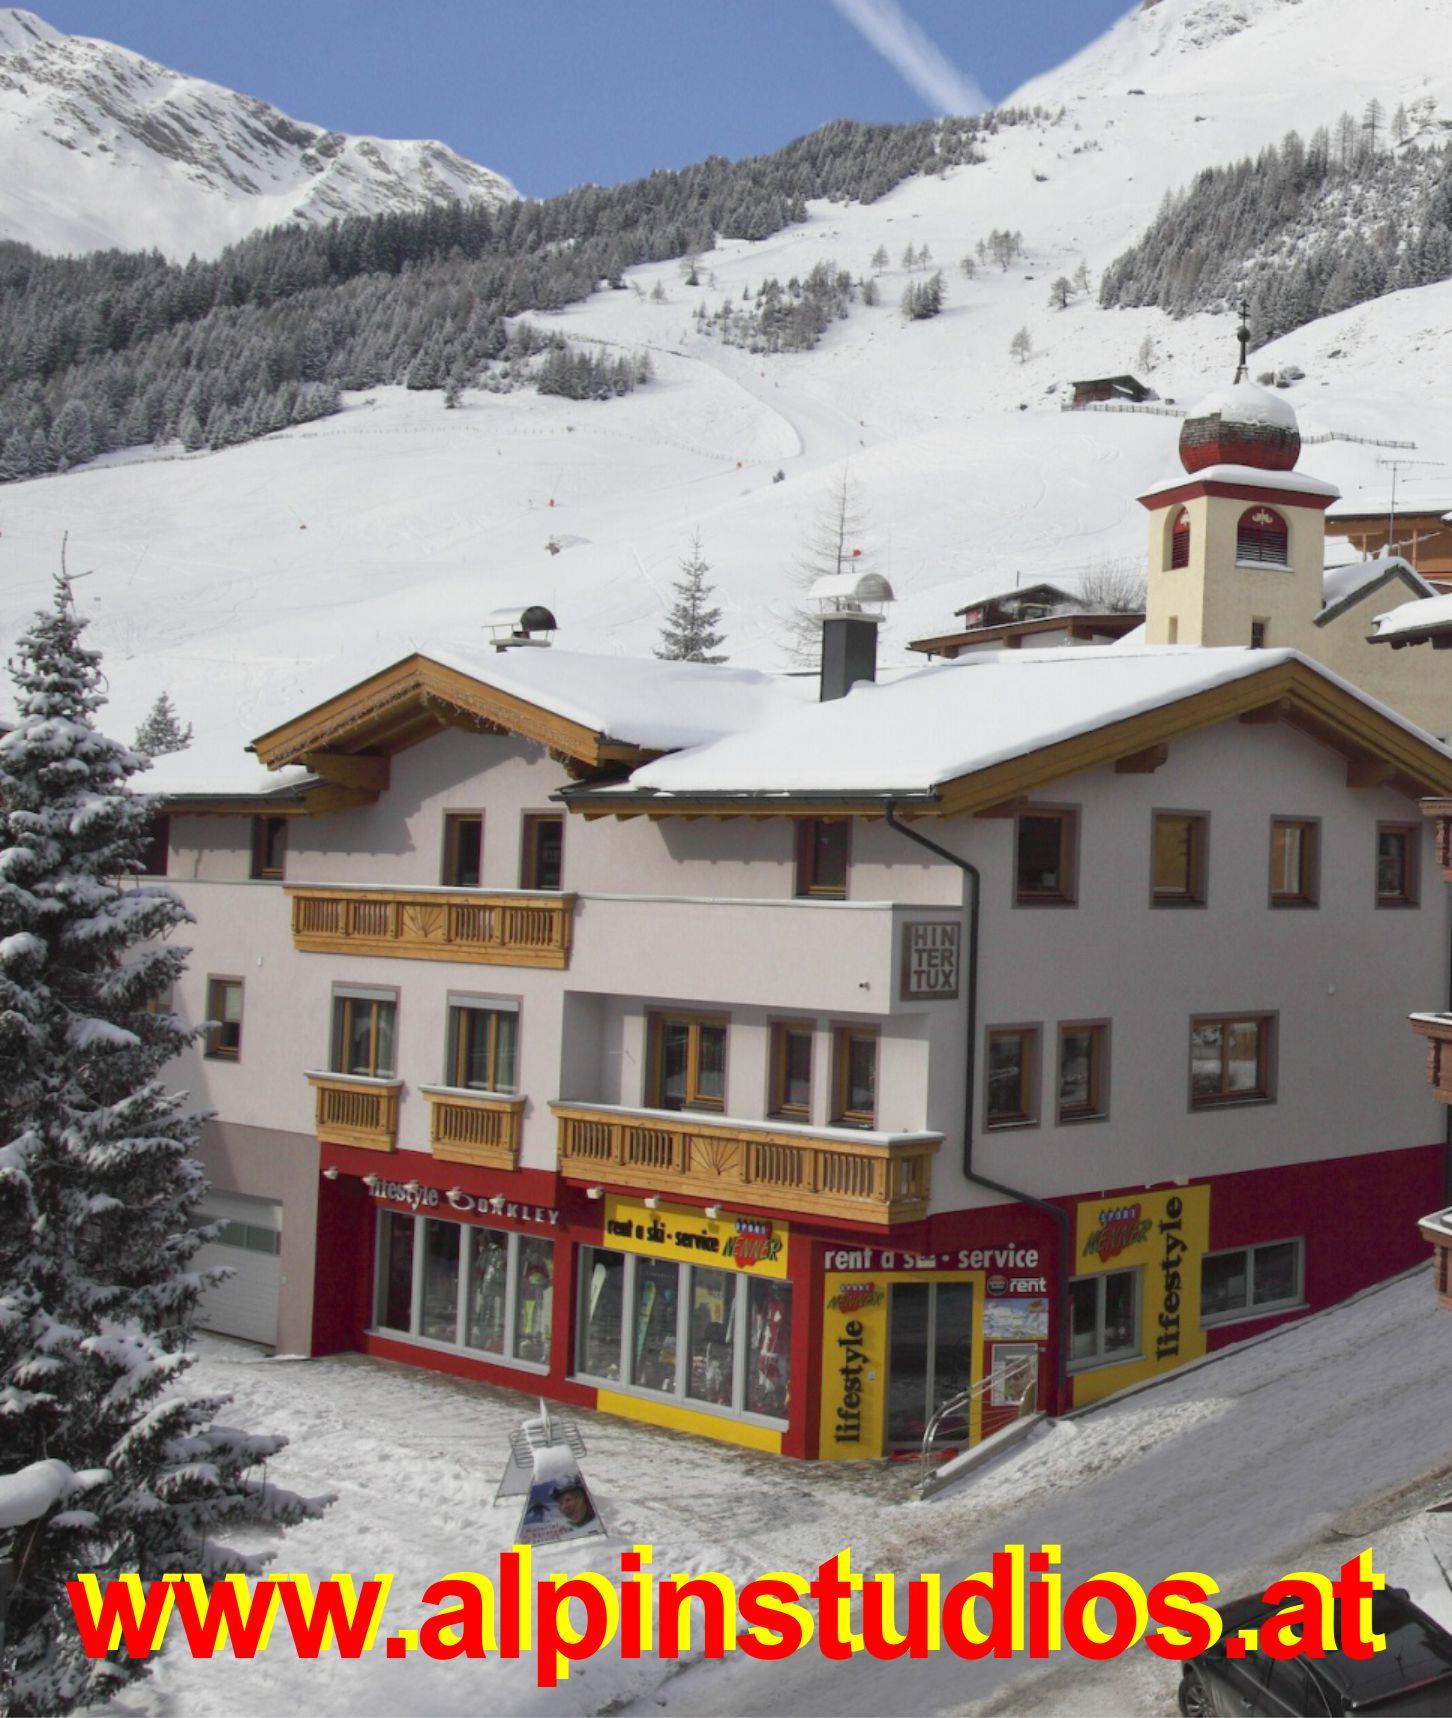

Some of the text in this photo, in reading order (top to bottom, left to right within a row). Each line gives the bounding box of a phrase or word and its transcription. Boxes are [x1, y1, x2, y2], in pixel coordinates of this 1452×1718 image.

[914, 926, 955, 947] HIN
[914, 948, 954, 968] TER
[913, 969, 954, 989] TUX
[1100, 1207, 1136, 1223] SPORT
[607, 1219, 633, 1238] rent
[674, 1229, 720, 1253] service
[825, 1248, 872, 1269] rent
[881, 1250, 895, 1269] a
[958, 1242, 1039, 1268] service
[1010, 1277, 1047, 1292] rent
[1156, 1196, 1188, 1361] lifestyle
[834, 1320, 870, 1442] lifestyle
